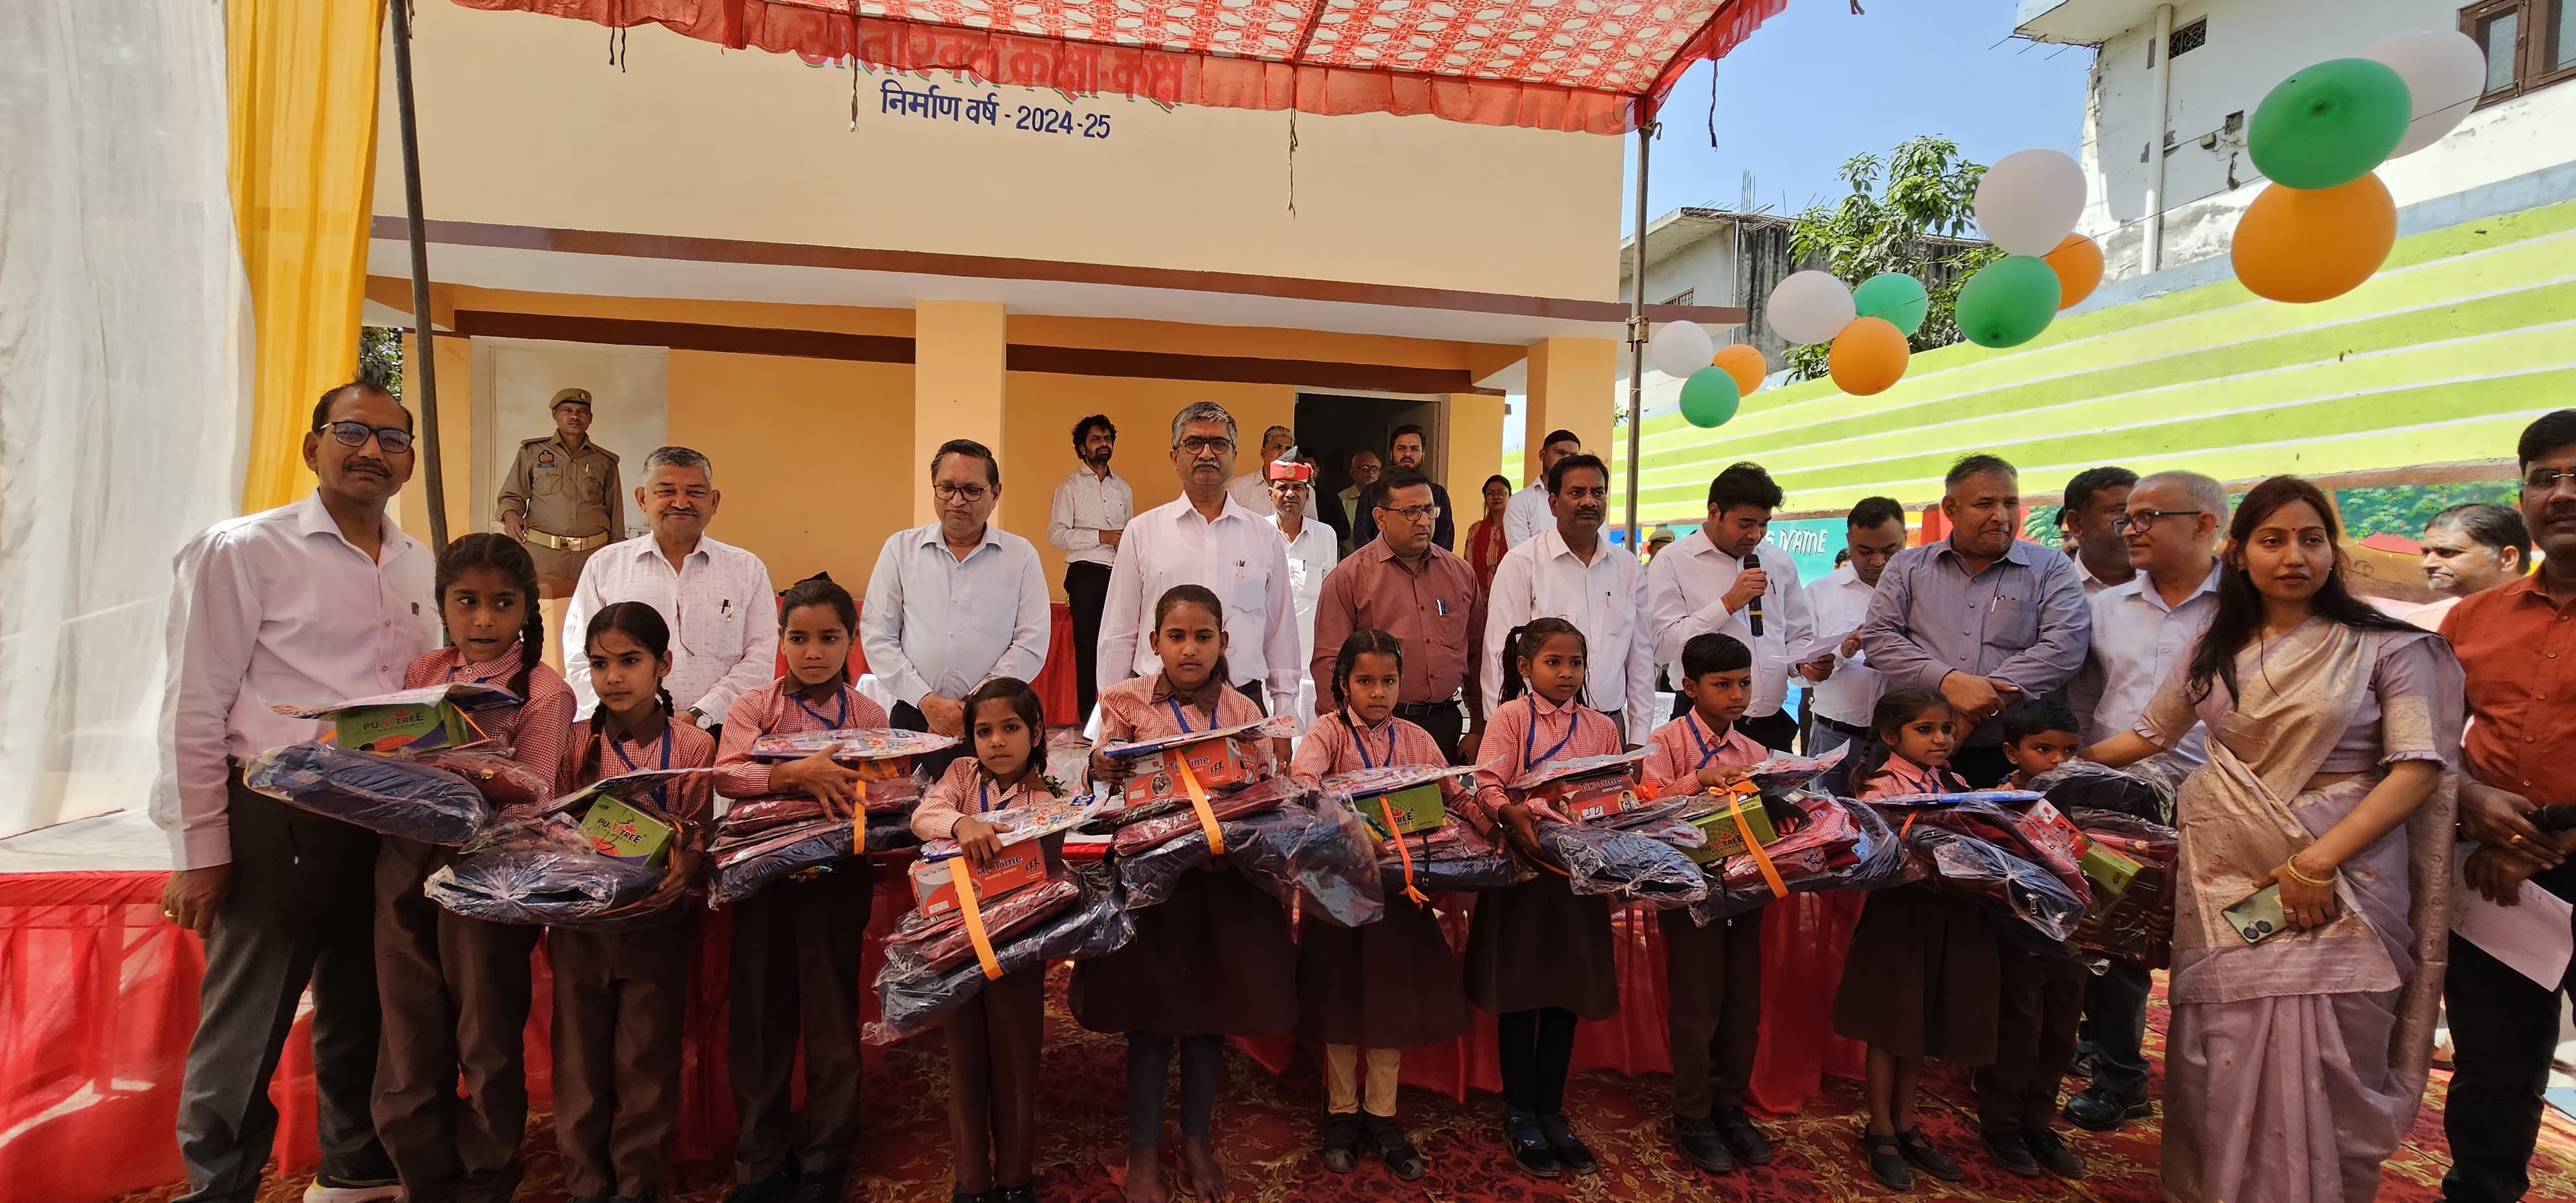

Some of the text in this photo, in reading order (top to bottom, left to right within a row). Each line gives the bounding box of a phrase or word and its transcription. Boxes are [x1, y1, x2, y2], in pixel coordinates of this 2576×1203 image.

[880, 79, 963, 122] निर्माण
[966, 92, 1000, 126] वर्ष
[1779, 529, 1828, 556] NAME
[995, 855, 1023, 869] Time
